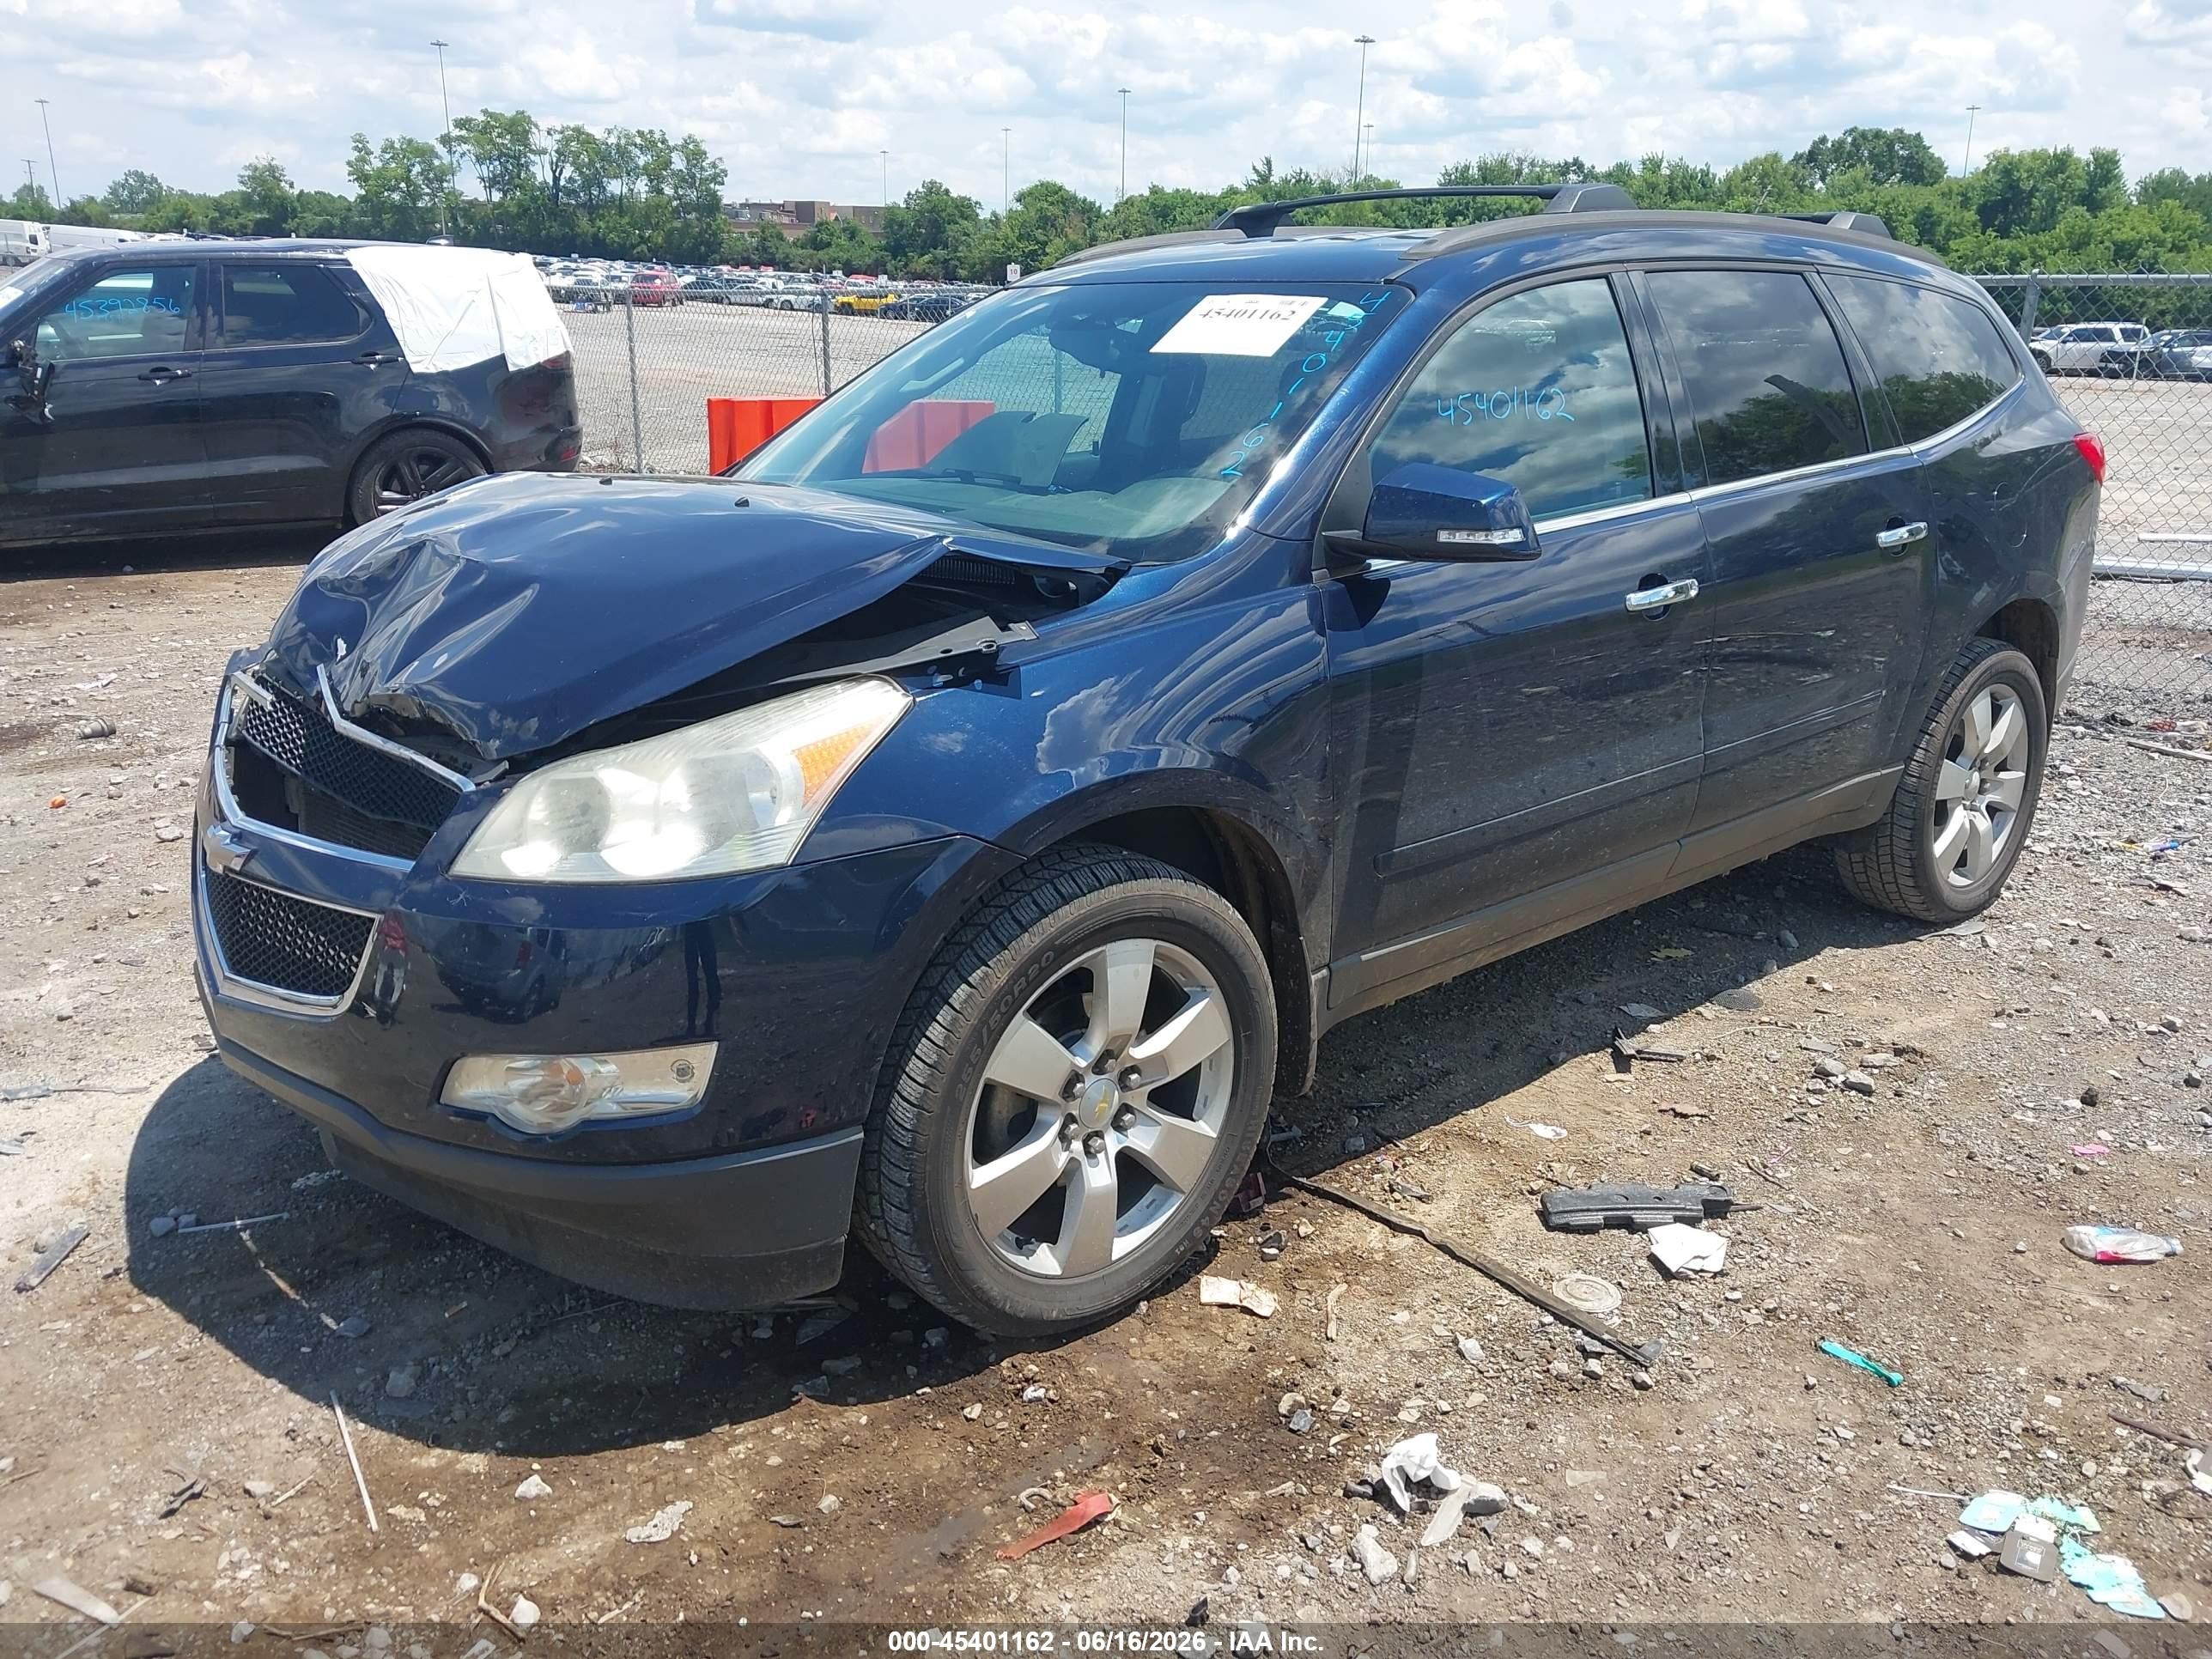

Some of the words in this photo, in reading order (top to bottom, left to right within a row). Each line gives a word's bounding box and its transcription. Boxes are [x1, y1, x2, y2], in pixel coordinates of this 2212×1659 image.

[64, 297, 180, 323] 45392856
[1199, 307, 1297, 321] 45401162
[1437, 386, 1576, 426] 45401162
